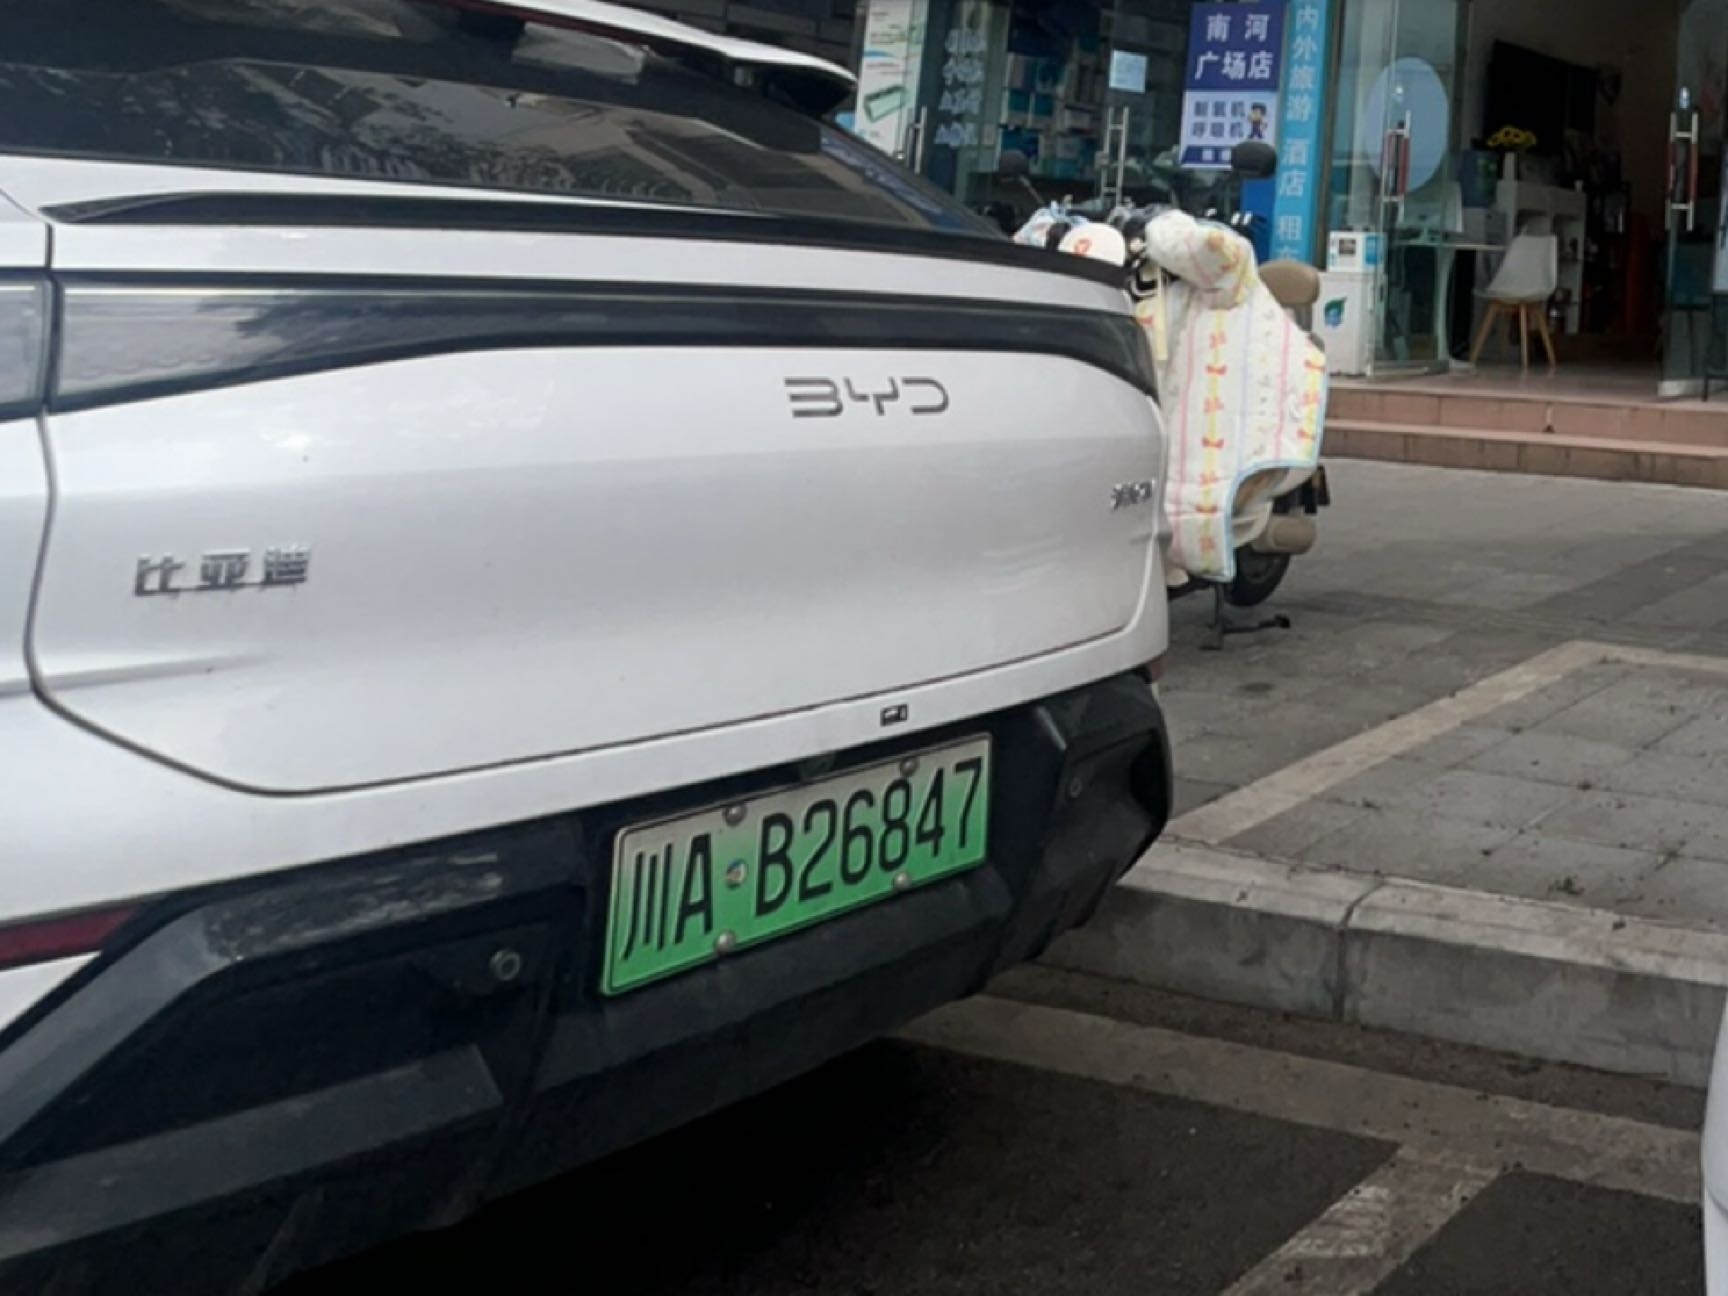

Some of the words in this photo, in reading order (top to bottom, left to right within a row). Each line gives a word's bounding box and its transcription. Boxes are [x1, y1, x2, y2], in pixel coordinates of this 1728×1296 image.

[1206, 13, 1270, 42] 南河
[1195, 51, 1274, 80] 广场店
[1280, 137, 1308, 197] 酒店
[783, 376, 950, 418] BYD
[134, 546, 312, 598] 比亚迪
[620, 832, 714, 961] 川A
[754, 755, 984, 918] B26847
